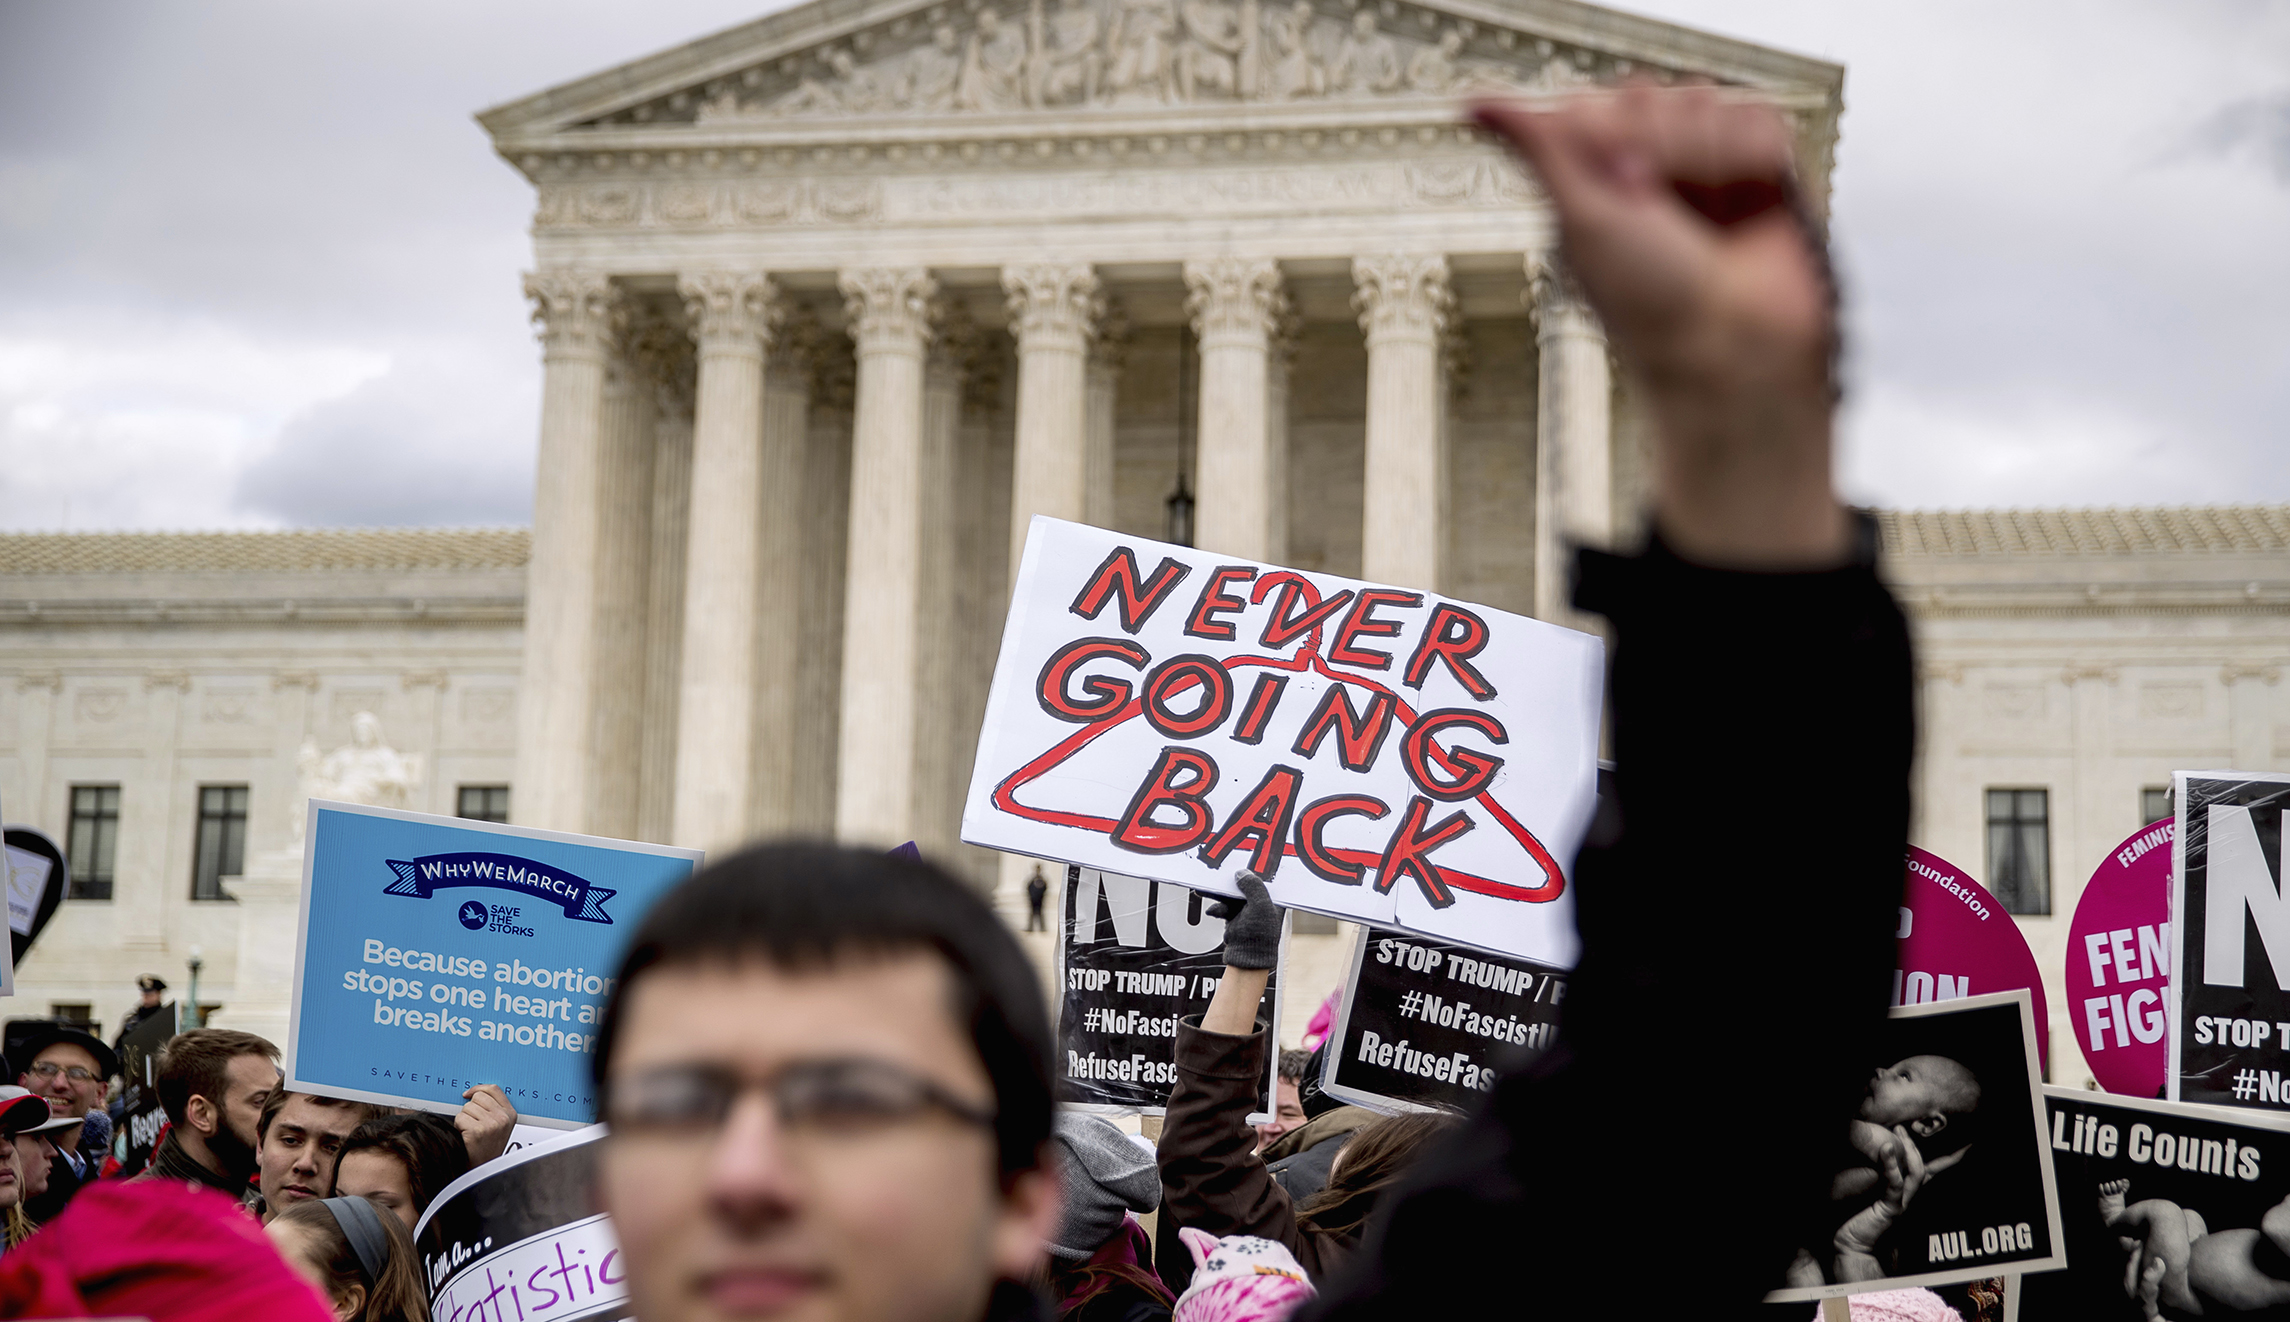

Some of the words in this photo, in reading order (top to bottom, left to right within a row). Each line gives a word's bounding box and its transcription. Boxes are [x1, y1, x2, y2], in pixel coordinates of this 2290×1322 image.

[1070, 546, 1498, 702] NEVER
[1036, 637, 1509, 802] GOING
[1109, 745, 1476, 909] BACK
[488, 923, 535, 938] STORKS
[490, 904, 521, 918] SAVE
[490, 914, 513, 926] THE
[363, 938, 487, 979] Because
[1376, 939, 1442, 974] STOP
[1447, 954, 1533, 996] TRUMP
[343, 968, 423, 1001] stops
[430, 984, 486, 1009] one
[494, 986, 571, 1021] heart
[1069, 967, 1110, 992] STOP
[1115, 971, 1186, 998] TRUMP
[374, 999, 472, 1037] breaks
[478, 1020, 598, 1054] another.
[2195, 1015, 2270, 1048] STOP
[371, 1067, 592, 1105] SAVETHESRKS.COM
[2052, 1110, 2119, 1158] Life
[2128, 1123, 2261, 1182] Counts
[1928, 1222, 2034, 1263] AUL.ORG
[433, 1251, 450, 1288] am
